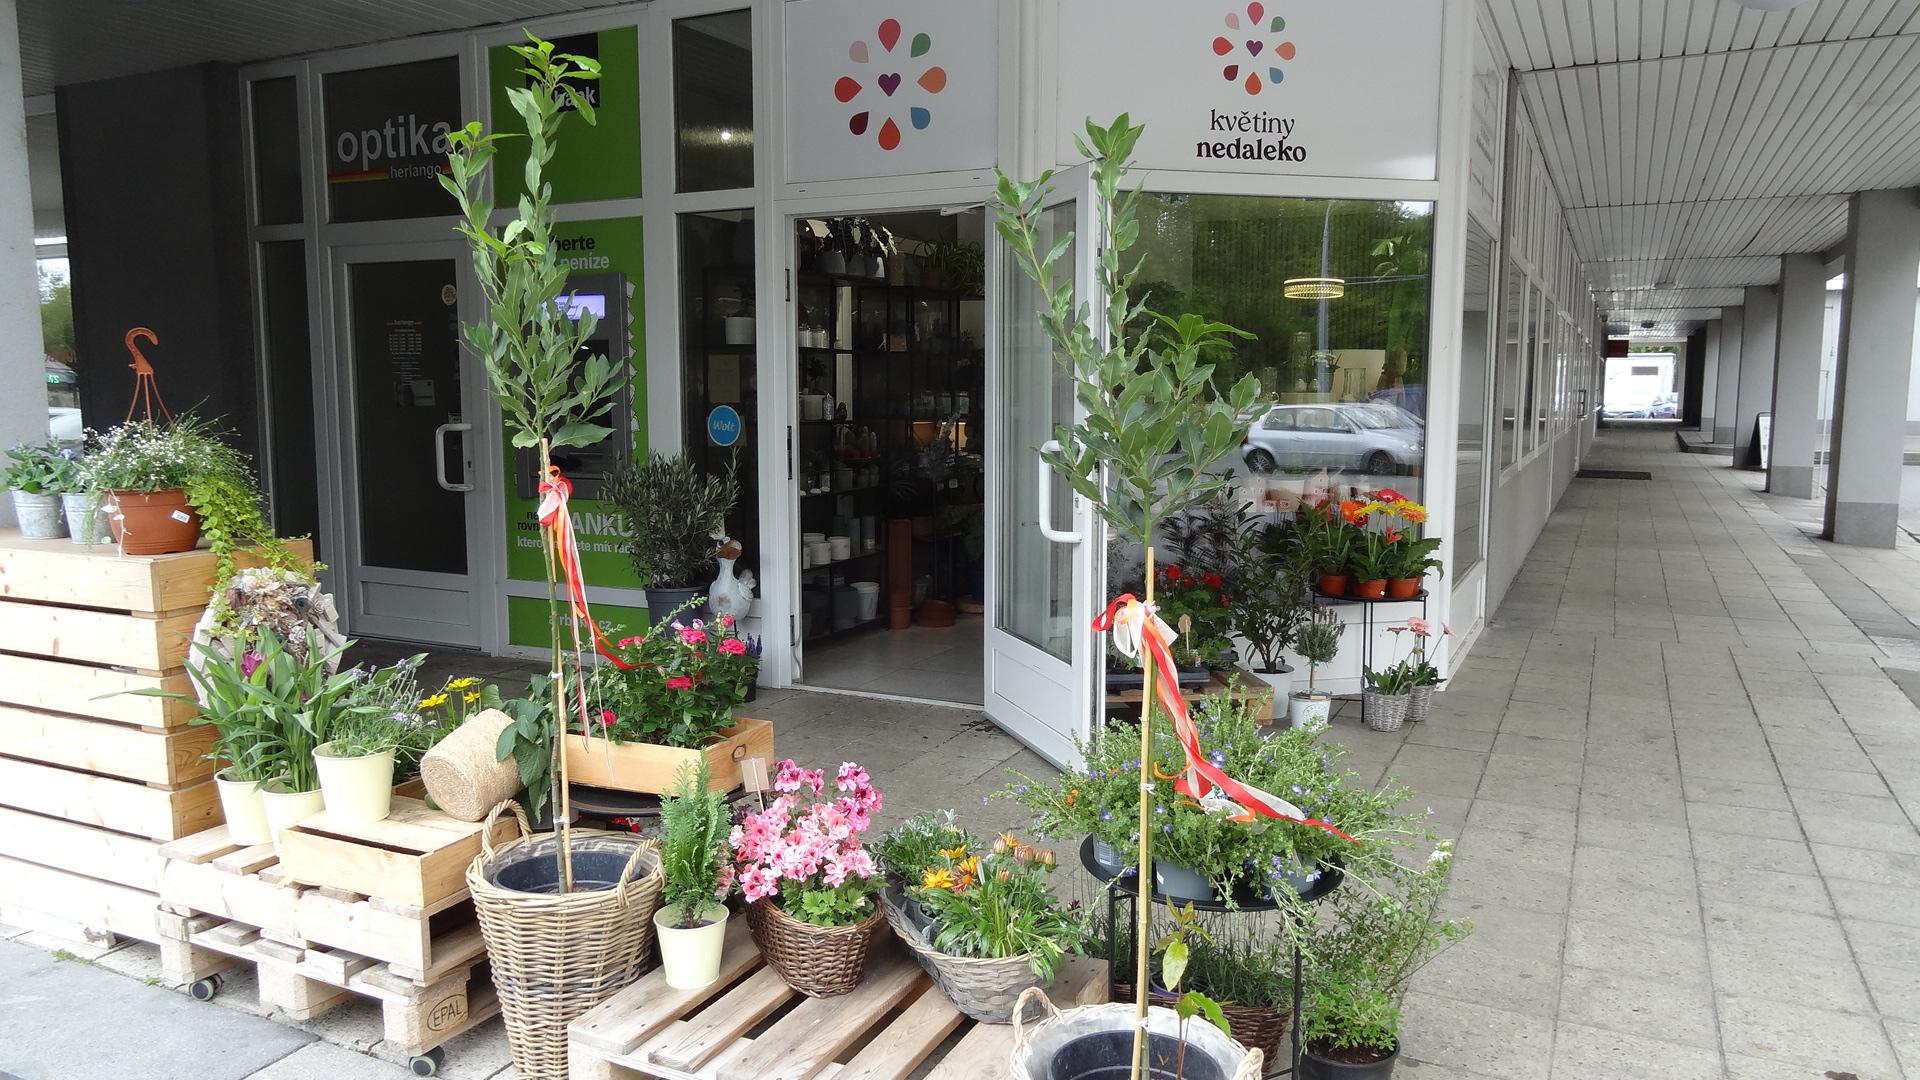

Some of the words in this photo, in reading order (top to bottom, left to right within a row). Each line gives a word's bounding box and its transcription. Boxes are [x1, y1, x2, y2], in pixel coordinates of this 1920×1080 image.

[1210, 109, 1295, 140] květiny
[337, 114, 453, 172] optika
[1196, 137, 1307, 162] nedaleko
[390, 165, 442, 179] herlango
[712, 420, 736, 432] Wolt
[570, 511, 636, 537] ANKU
[433, 1000, 464, 1028] EPAL
